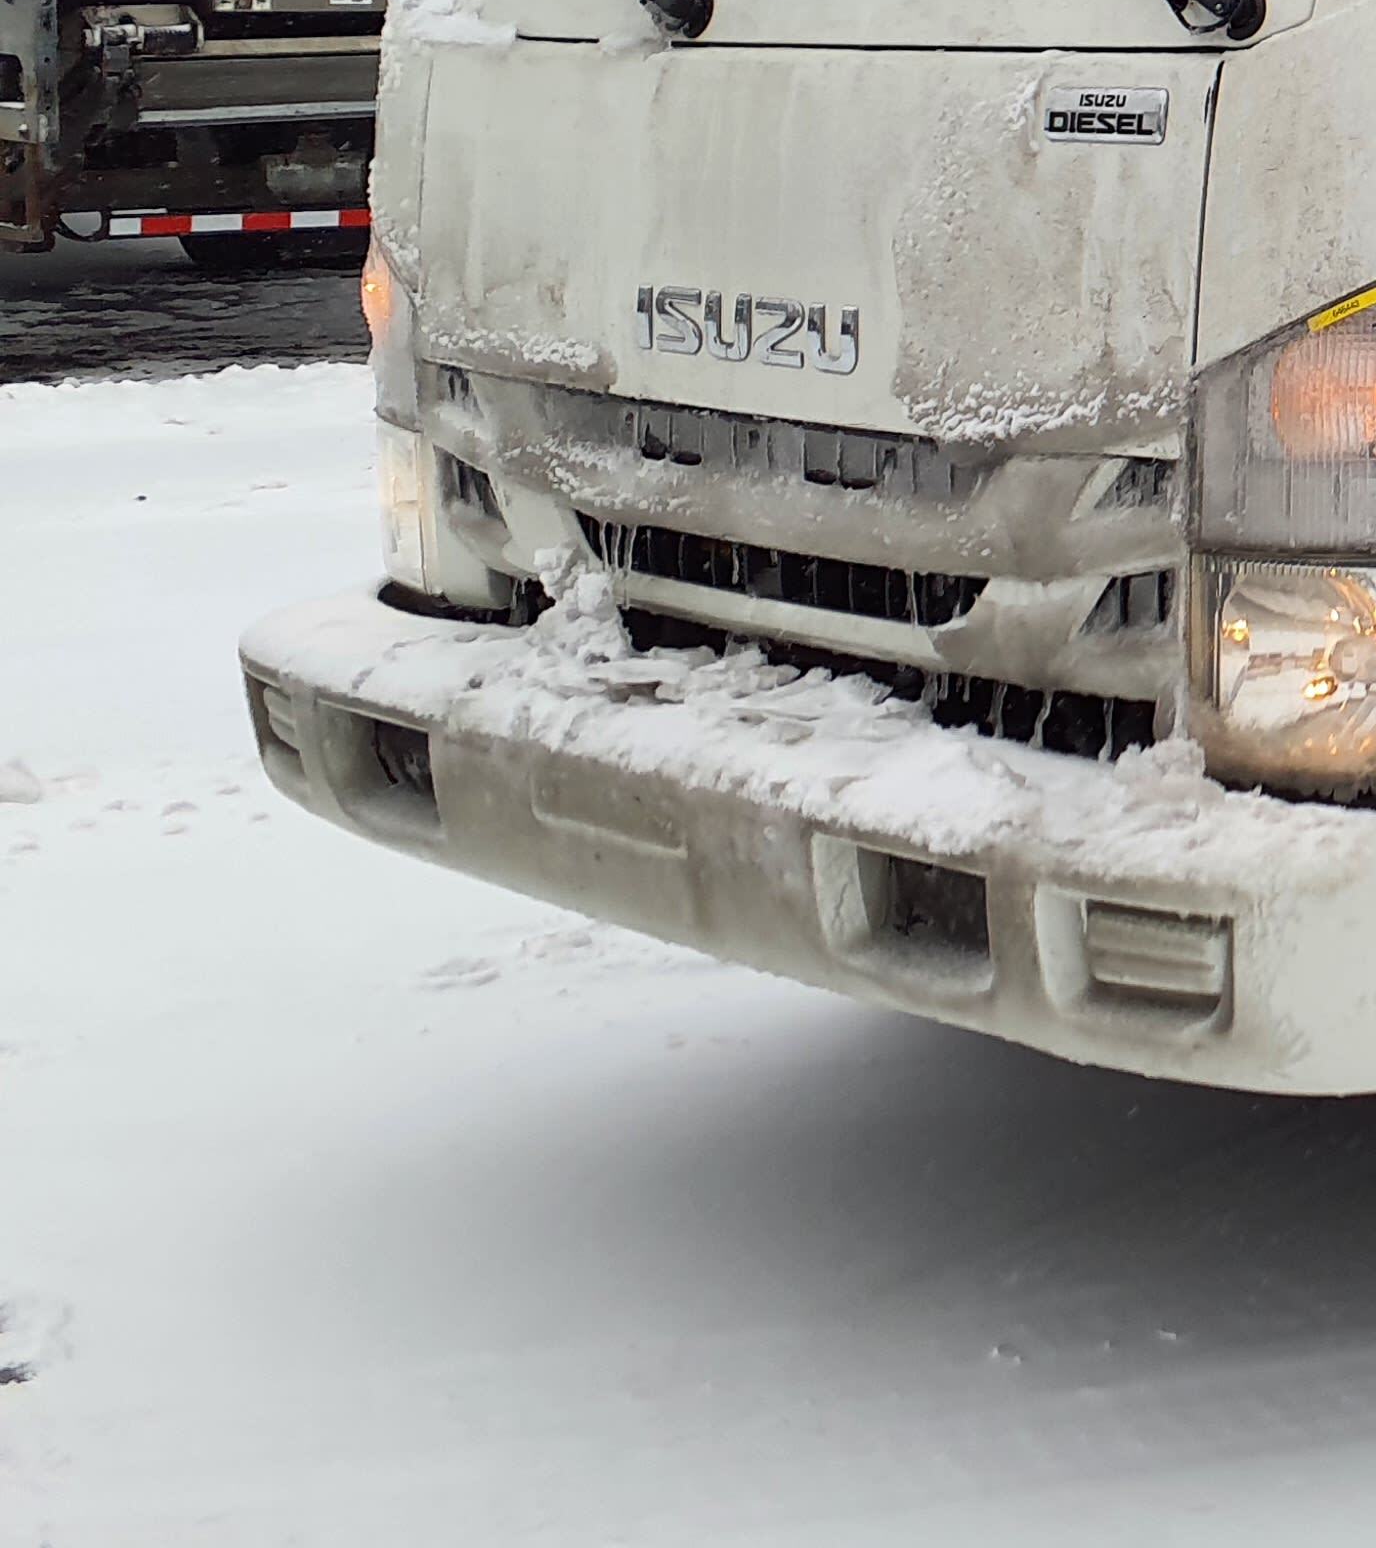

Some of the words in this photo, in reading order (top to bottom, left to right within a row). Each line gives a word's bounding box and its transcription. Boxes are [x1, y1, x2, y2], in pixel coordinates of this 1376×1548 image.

[1079, 94, 1127, 108] ISUZU
[1048, 111, 1154, 135] DIESEL
[637, 283, 859, 375] ISUZU
